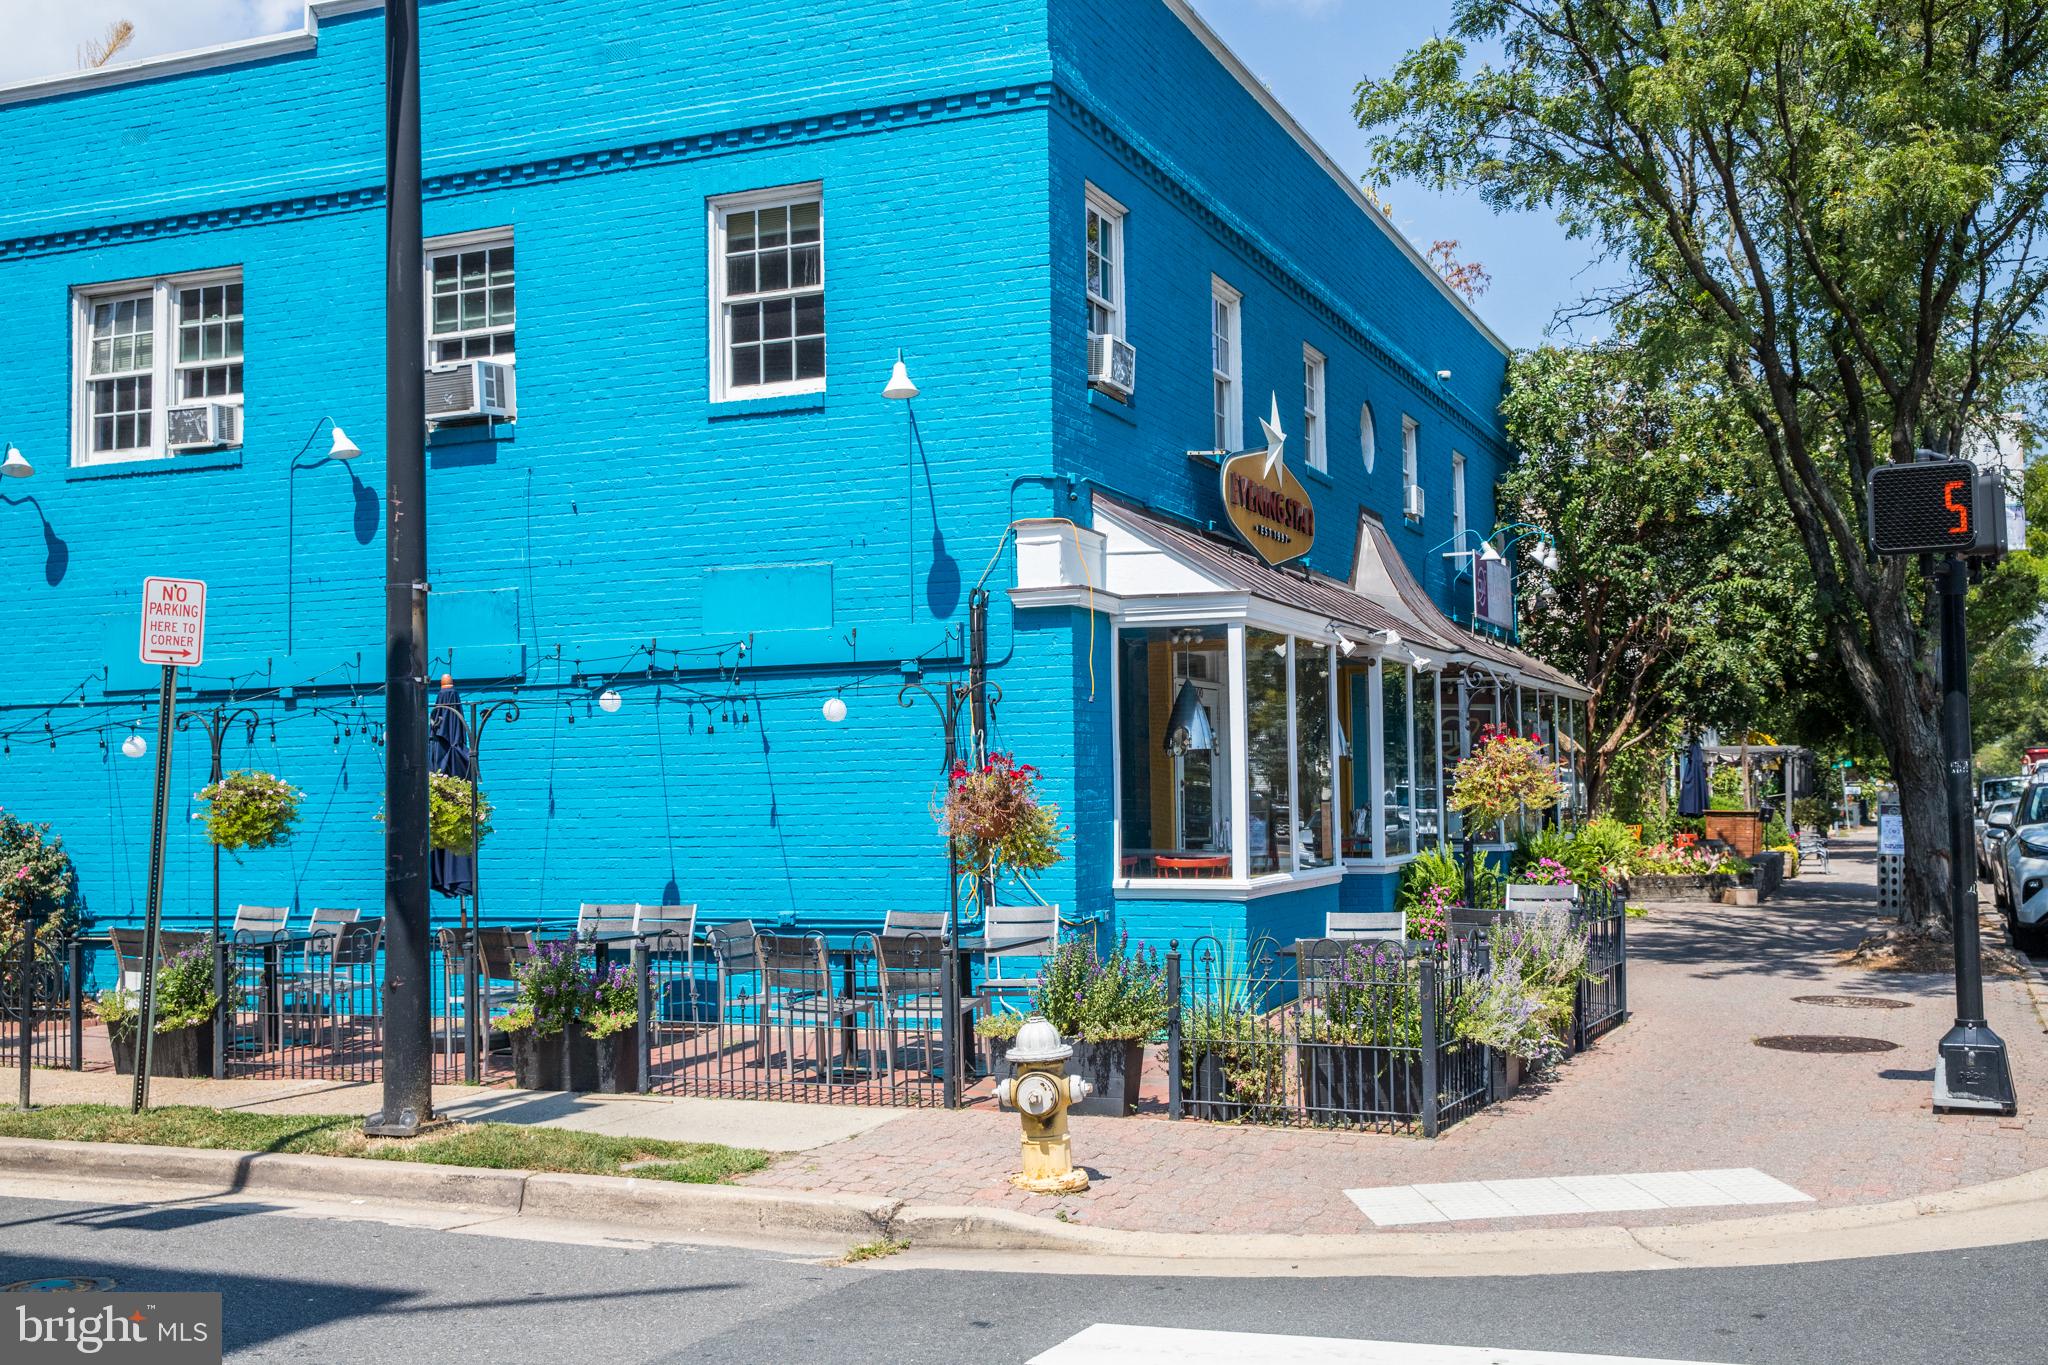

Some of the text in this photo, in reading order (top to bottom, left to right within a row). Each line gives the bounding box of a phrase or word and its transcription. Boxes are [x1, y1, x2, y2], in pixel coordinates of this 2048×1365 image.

[1230, 472, 1314, 536] EVENING STAR
[1944, 481, 1969, 534] 5
[162, 586, 187, 602] NO
[149, 602, 198, 618] PARKING
[150, 621, 195, 633] HERE TO
[151, 634, 193, 647] CORNER
